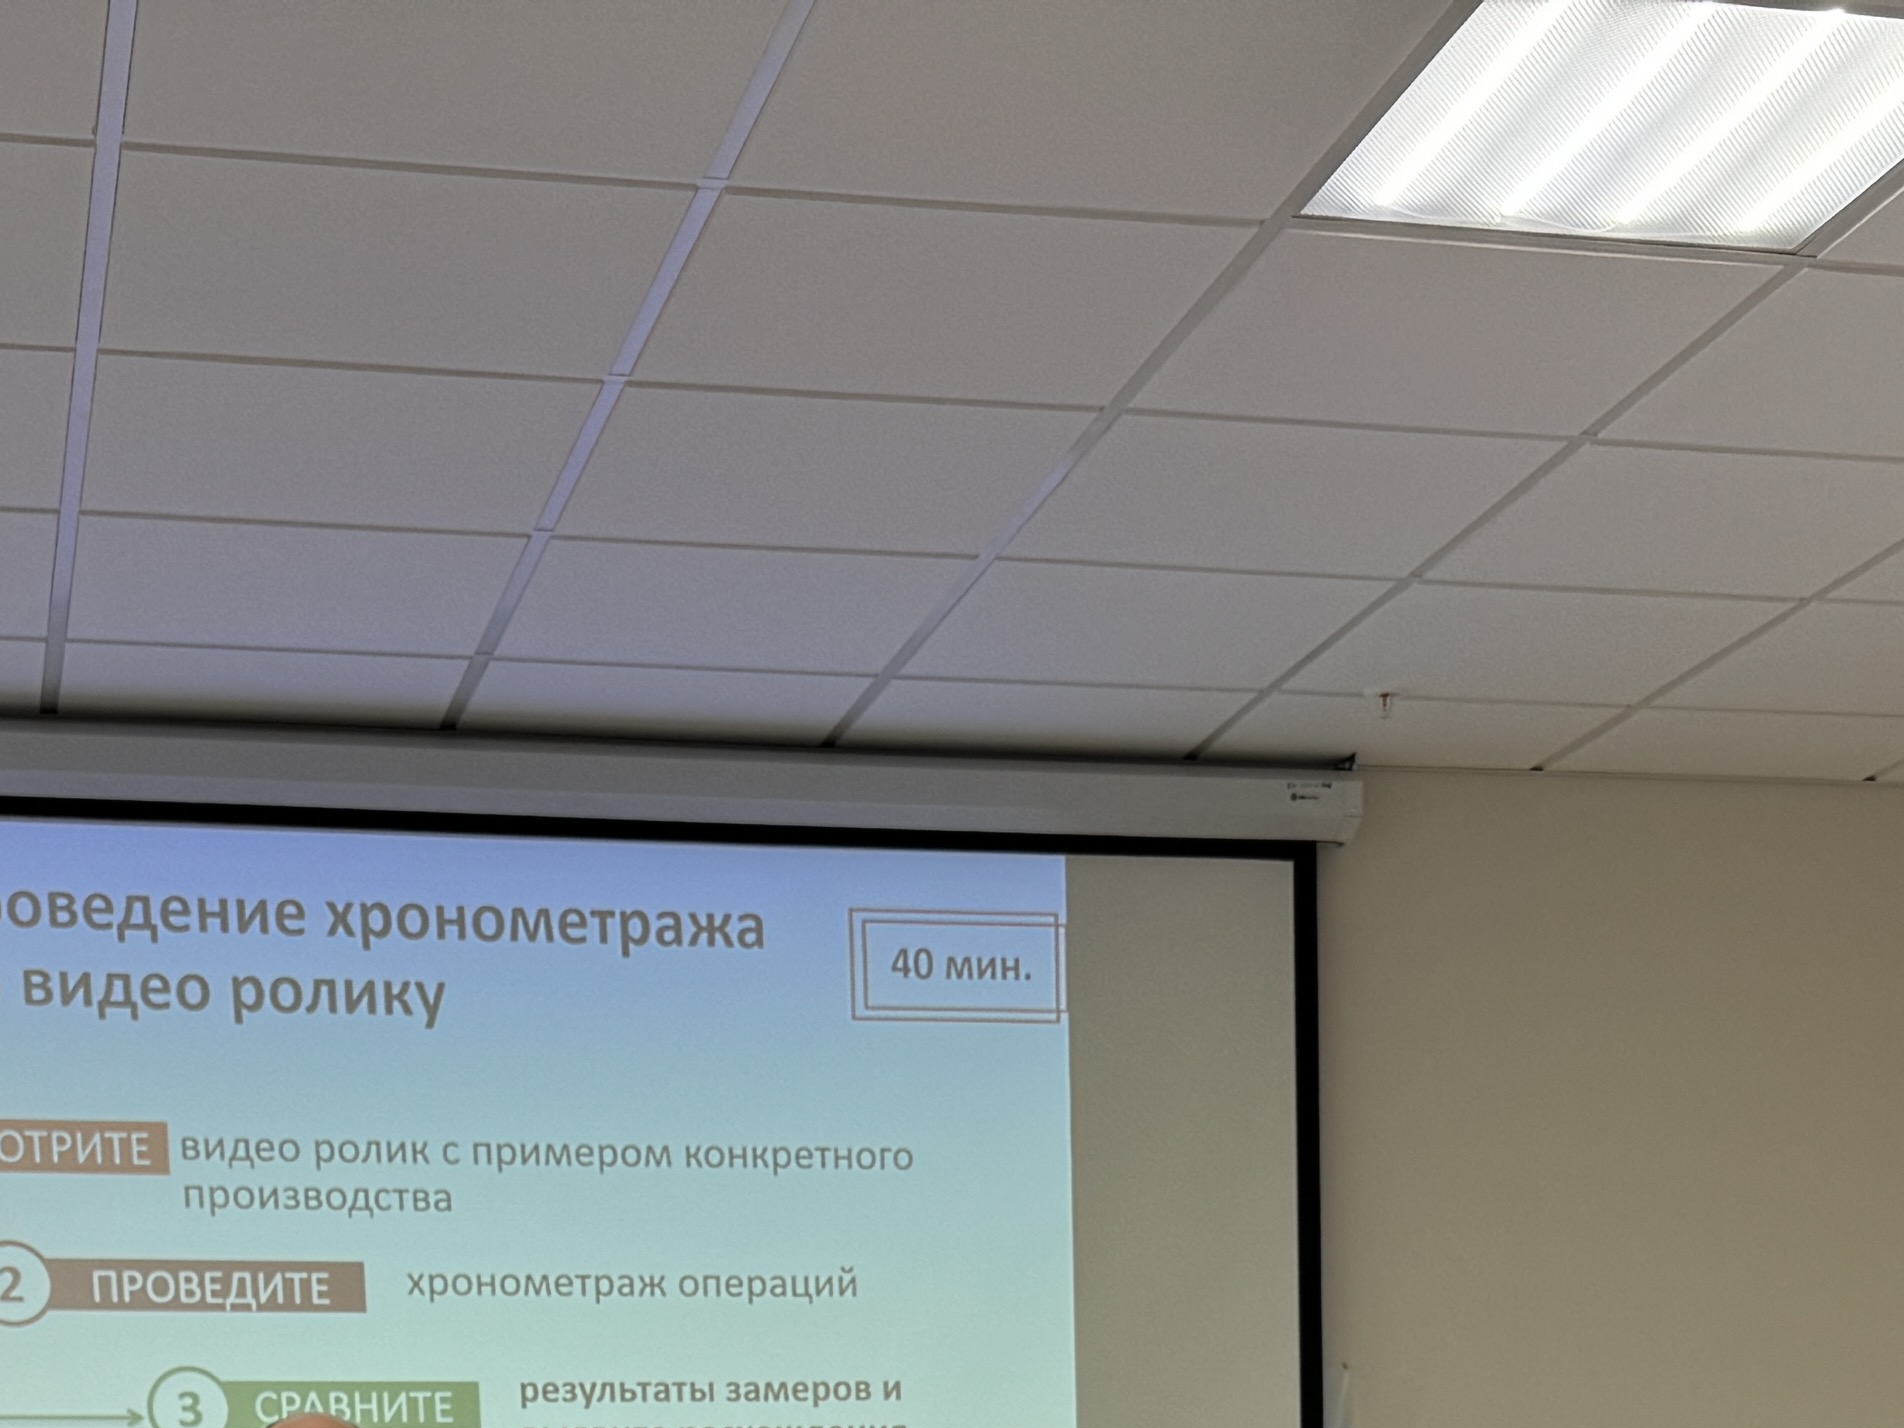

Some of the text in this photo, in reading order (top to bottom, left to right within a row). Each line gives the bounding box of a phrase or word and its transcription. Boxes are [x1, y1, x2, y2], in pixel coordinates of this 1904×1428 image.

[327, 899, 765, 957] хронометража
[891, 948, 1032, 982] 40 мин.
[23, 968, 211, 1020] видео
[233, 974, 446, 1029] ролику
[181, 1135, 915, 1176] видео ролик с примером конкретного
[183, 1182, 453, 1218] производства
[91, 1268, 331, 1311] ПРОВЕДИТЕ
[407, 1266, 858, 1304] хронометраж операций
[177, 1390, 203, 1428] 3
[254, 1390, 454, 1424] СРАВНИТЕ
[520, 1379, 903, 1410] результаты замеров и
